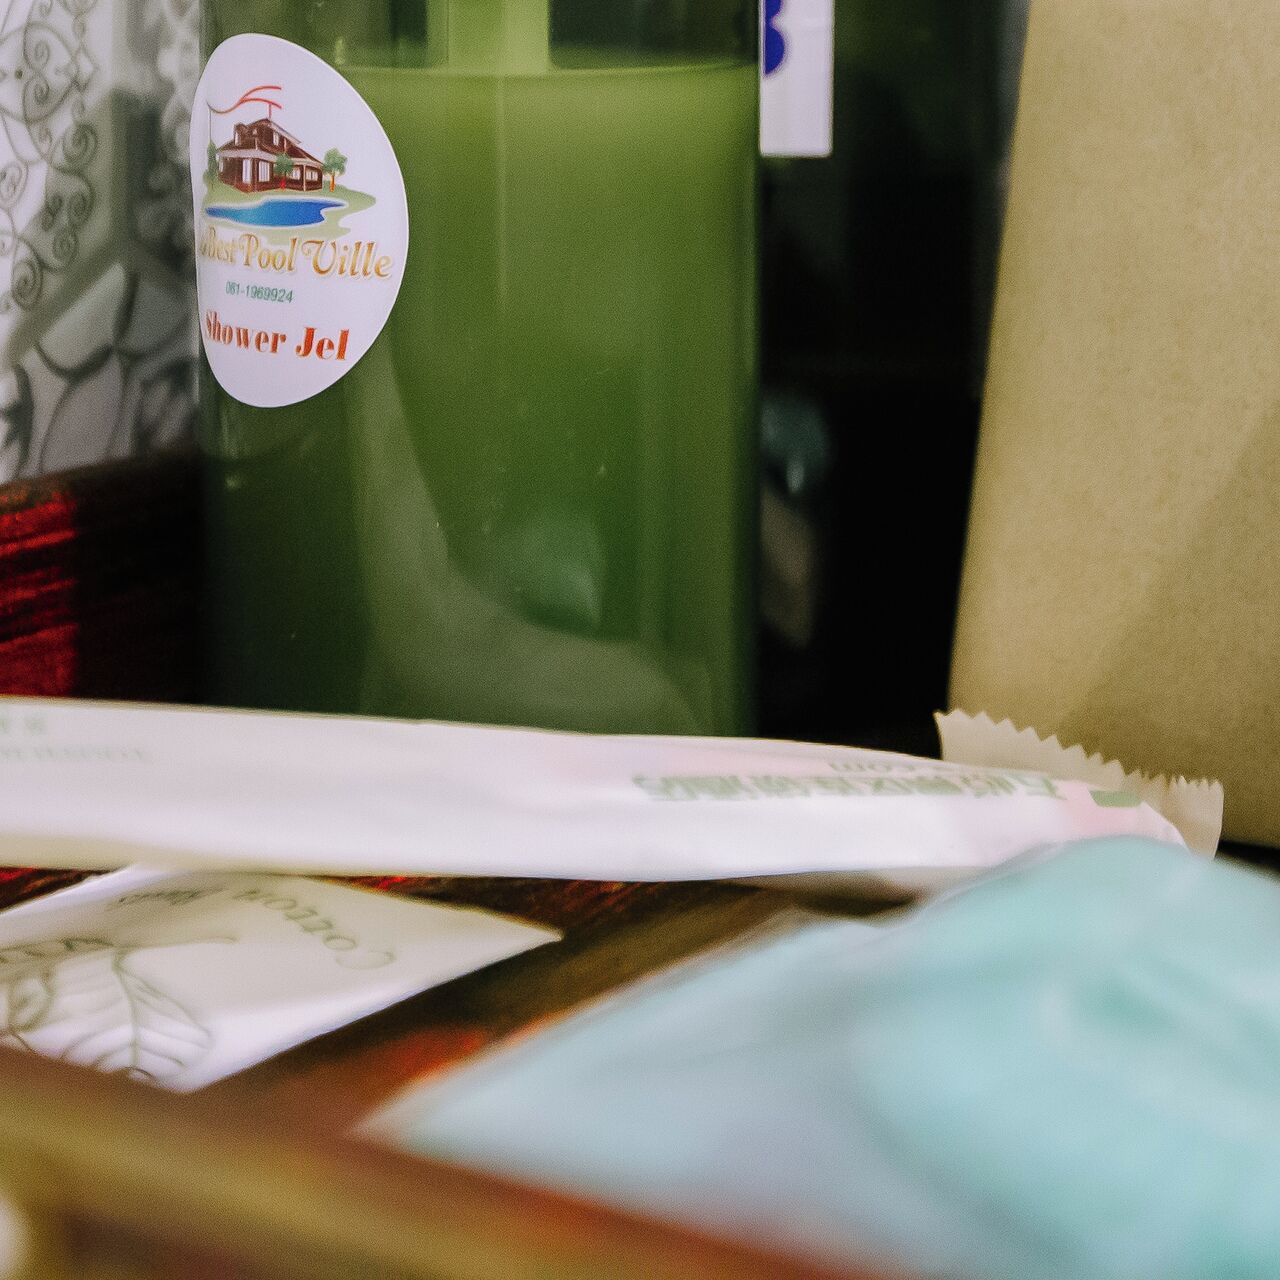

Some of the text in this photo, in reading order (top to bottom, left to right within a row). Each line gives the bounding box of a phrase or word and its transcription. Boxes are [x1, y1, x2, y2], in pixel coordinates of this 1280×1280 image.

[237, 233, 298, 273] Pool
[302, 239, 393, 278] Ville
[296, 326, 350, 360] Jel
